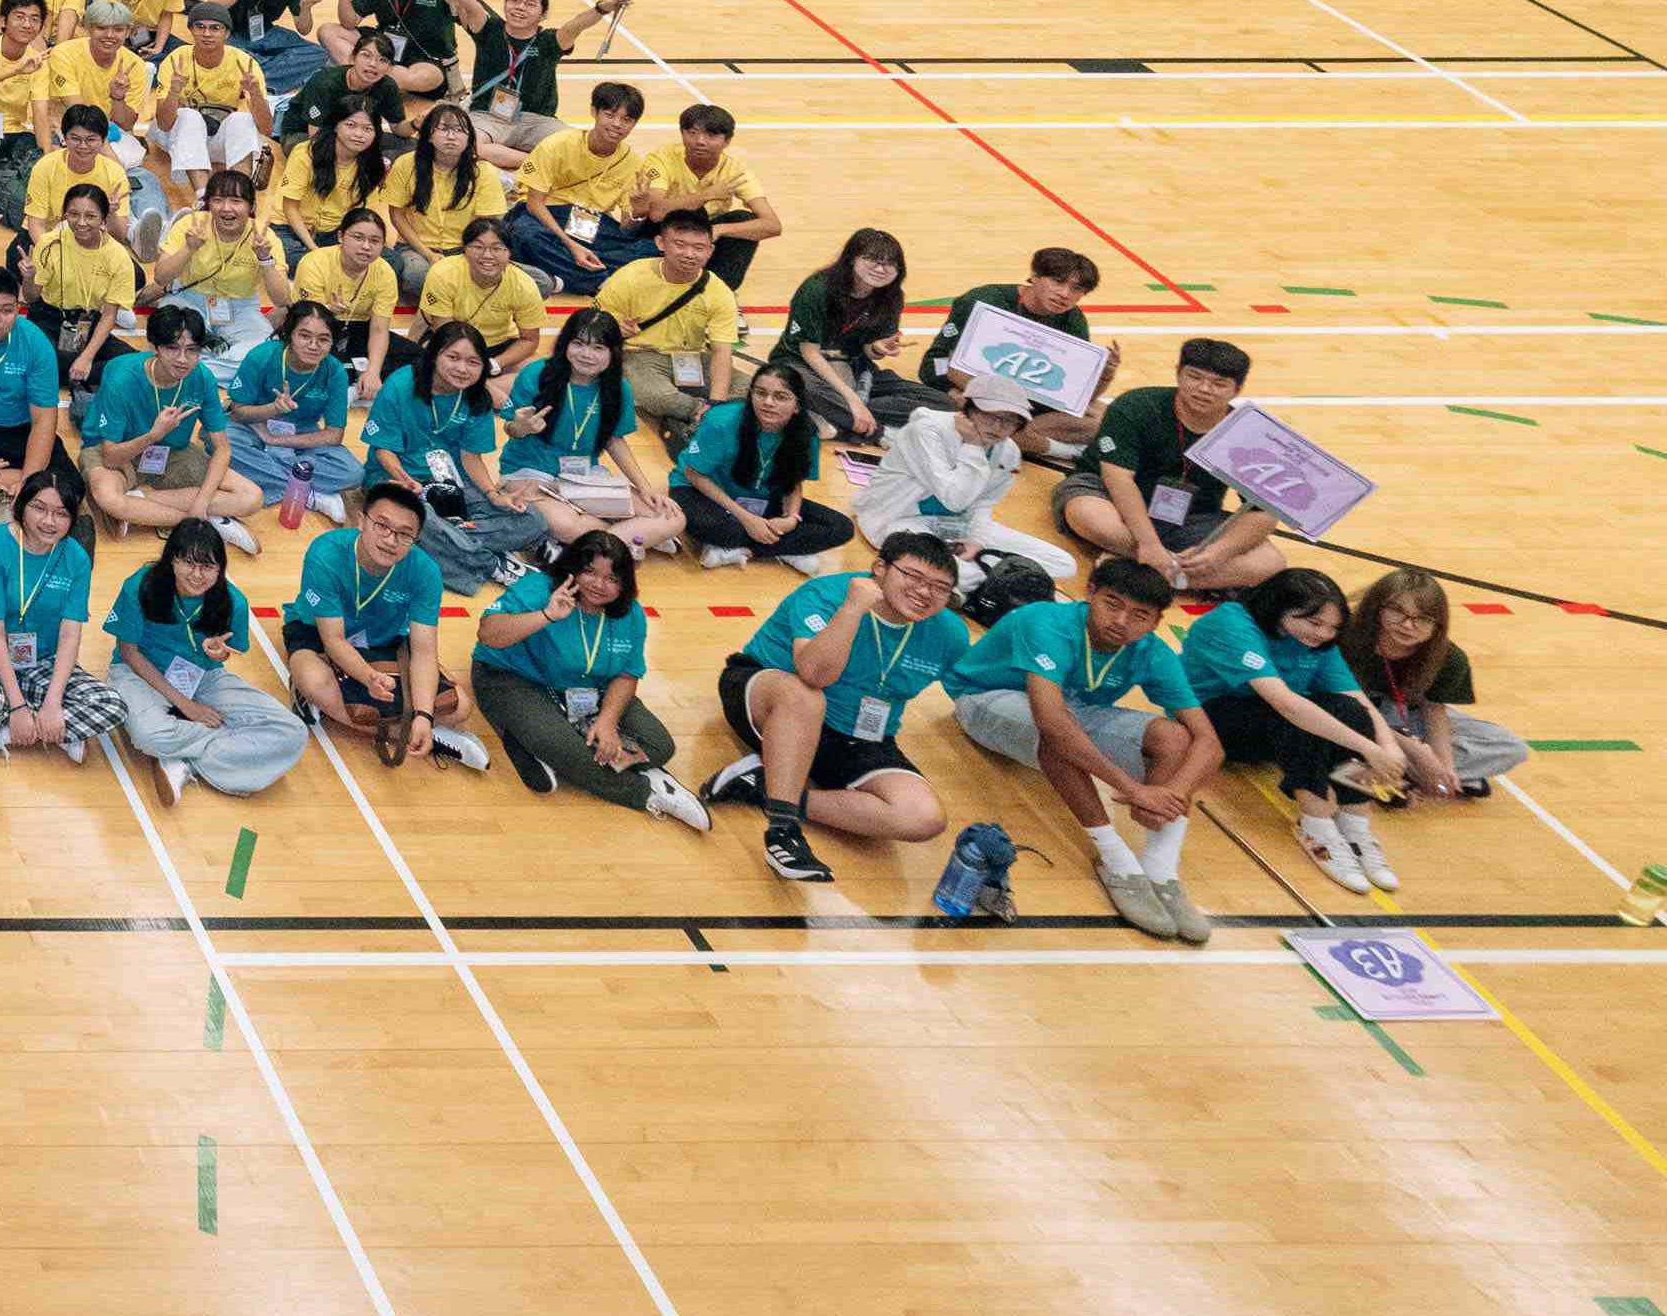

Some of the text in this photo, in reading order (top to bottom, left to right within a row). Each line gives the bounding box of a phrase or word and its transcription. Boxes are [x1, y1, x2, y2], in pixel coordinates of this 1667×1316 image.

[993, 351, 1052, 385] A2
[1239, 462, 1306, 498] A1
[1349, 944, 1404, 980] A3
